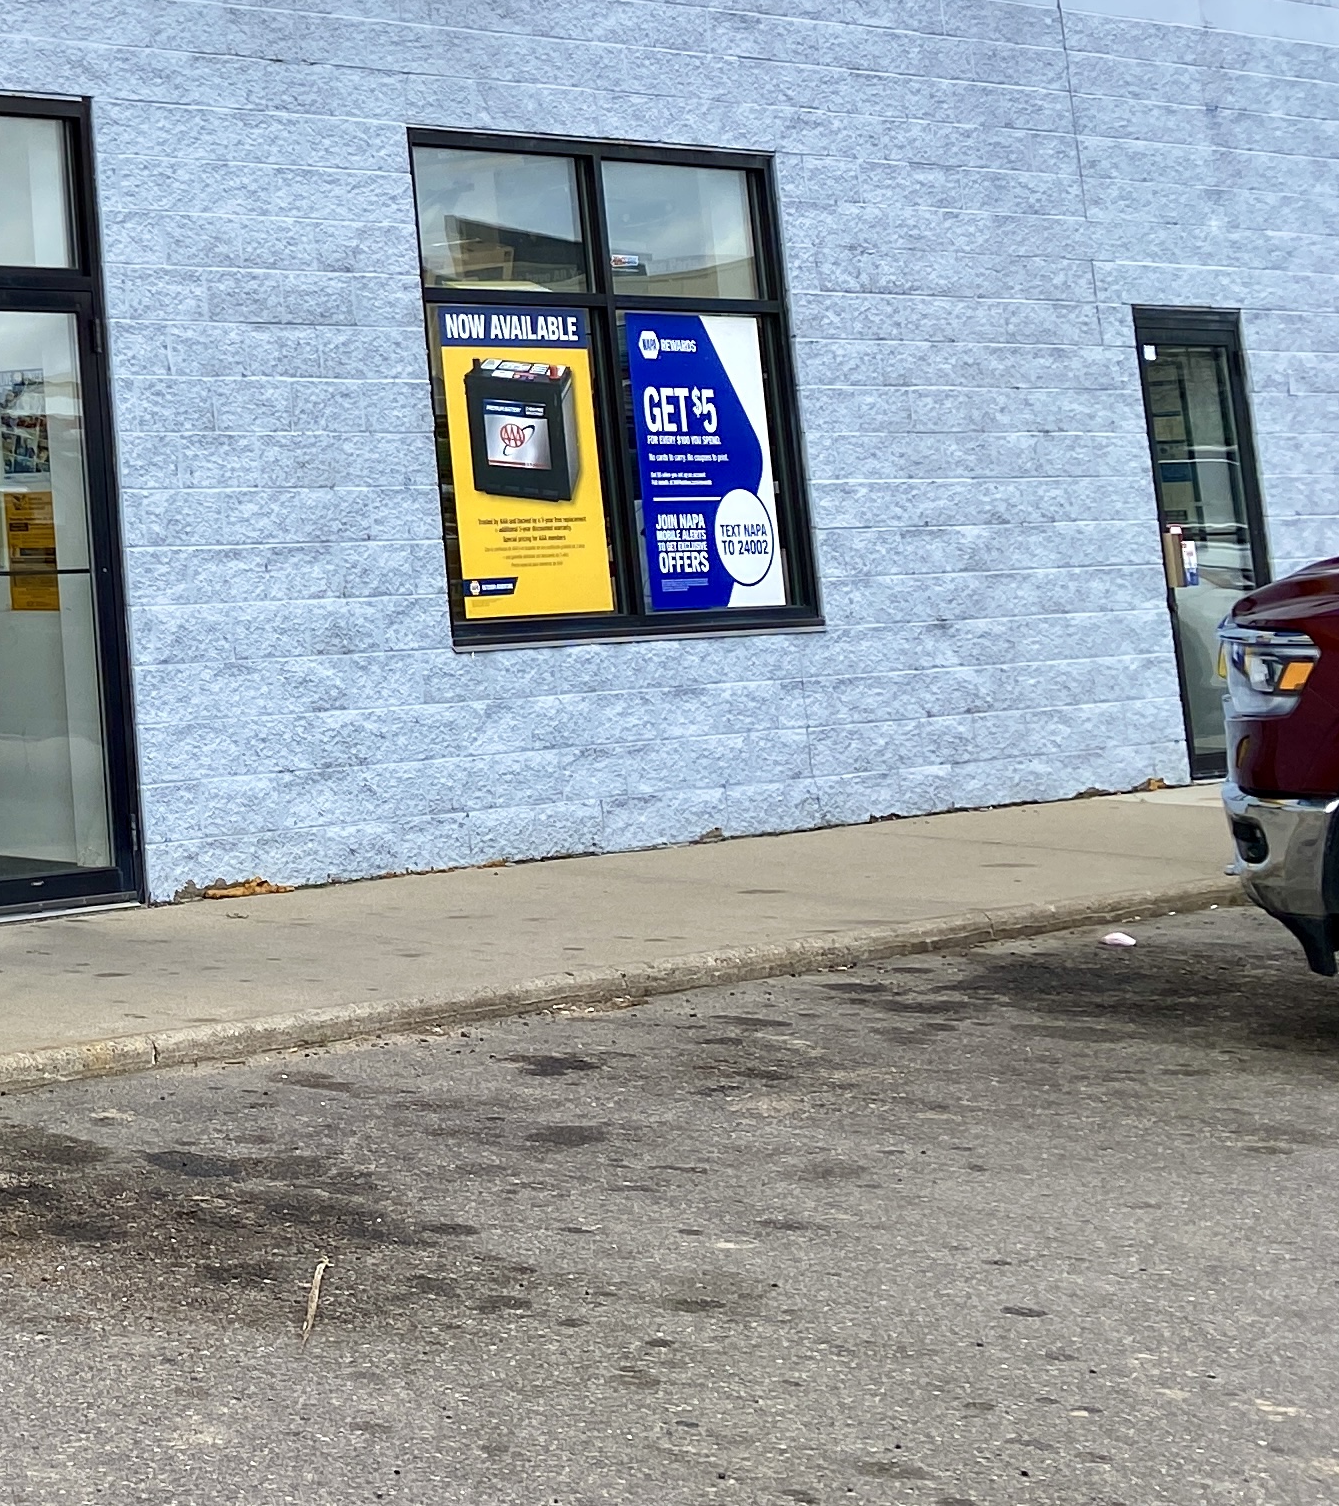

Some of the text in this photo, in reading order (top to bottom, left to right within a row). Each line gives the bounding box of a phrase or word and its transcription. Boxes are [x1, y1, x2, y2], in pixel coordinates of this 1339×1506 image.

[444, 313, 579, 341] NOW AVAILABLE
[643, 386, 718, 433] GET $5
[502, 424, 524, 447] AAA
[655, 513, 706, 529] JOIN NAPA
[720, 524, 768, 537] TEXT NAPA
[682, 530, 707, 540] ALERTS
[721, 540, 769, 555] TO 24002
[659, 551, 710, 573] OFFERS
